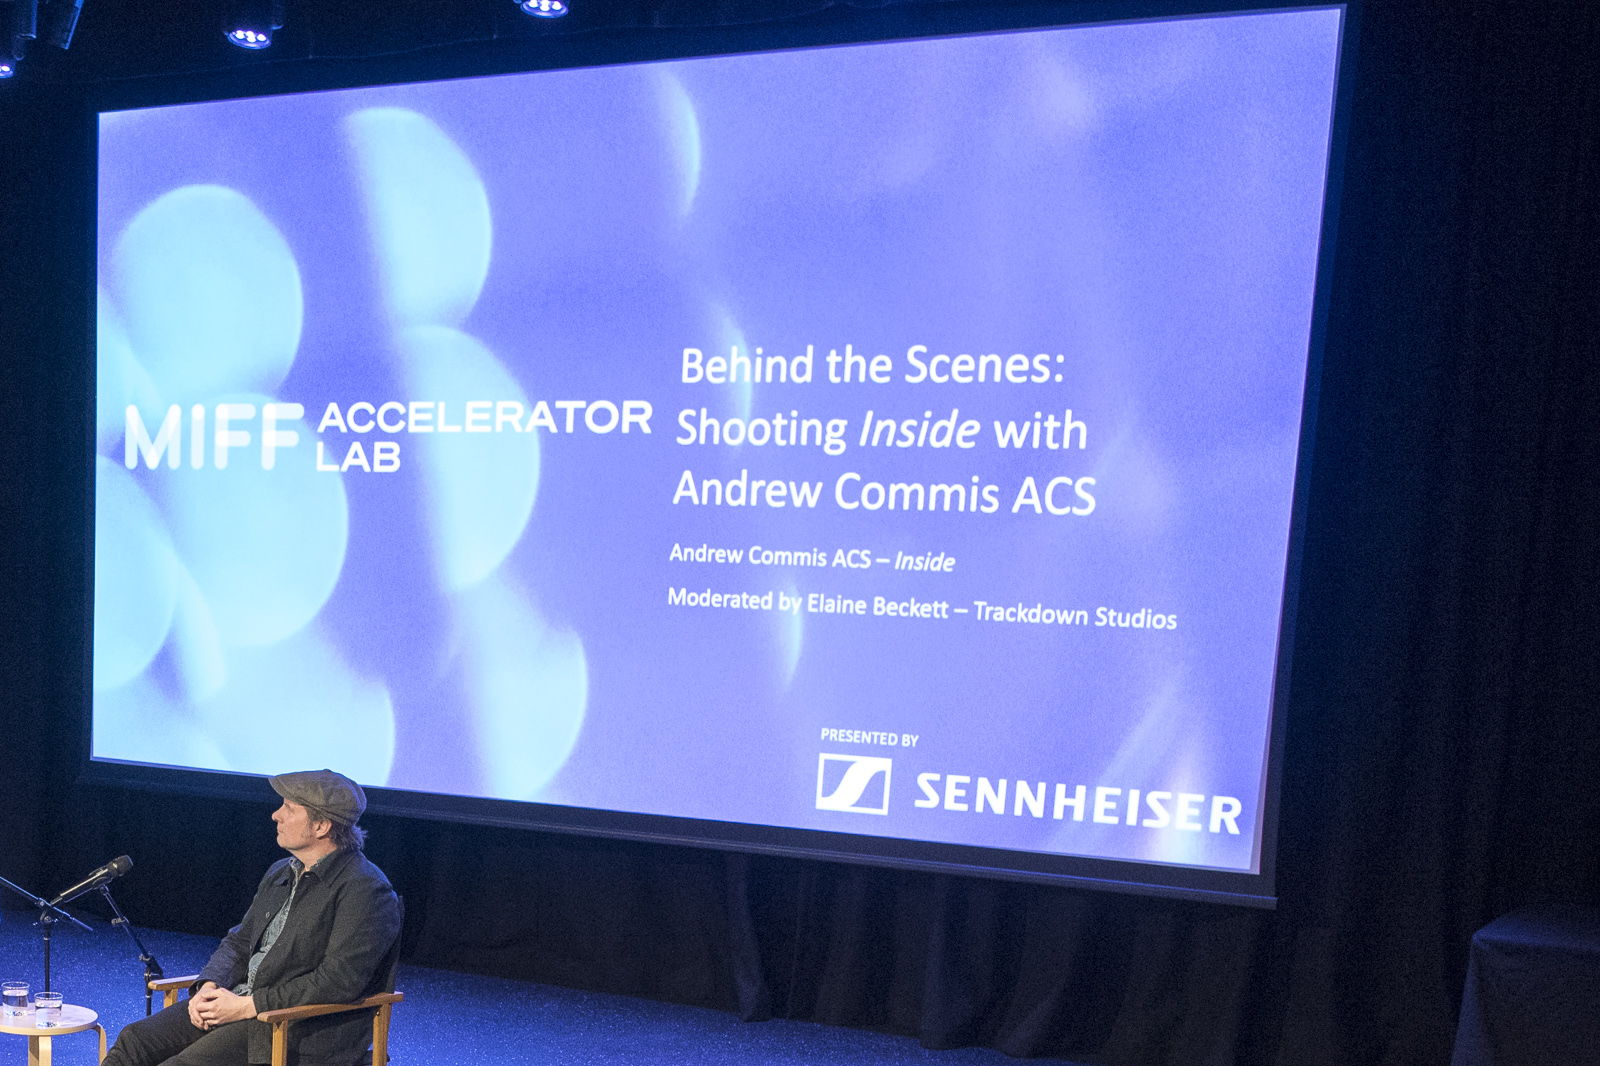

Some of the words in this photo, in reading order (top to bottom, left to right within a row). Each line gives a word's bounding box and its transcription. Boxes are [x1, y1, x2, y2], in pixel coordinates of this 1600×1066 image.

[681, 344, 814, 384] Behind
[825, 343, 893, 384] the
[904, 344, 1066, 384] Scenes:
[124, 403, 305, 470] MIFF
[317, 399, 653, 435] ACCELERATOR
[675, 407, 849, 456] Shooting
[858, 408, 982, 449] Inside
[993, 409, 1088, 450] with
[316, 440, 401, 473] LAB
[672, 469, 824, 507] Andrew
[834, 471, 1000, 514] Commis
[1011, 475, 1097, 516] ACS
[669, 542, 744, 564] Andrew
[748, 545, 827, 568] Commis
[831, 548, 872, 569] ACS
[894, 550, 956, 573] Inside
[667, 586, 773, 611] Moderated
[778, 591, 804, 615] by
[807, 593, 868, 615] Elaine
[872, 595, 950, 619] Beckett
[973, 600, 1090, 625] Trackdown
[1094, 606, 1178, 630] Studios
[820, 727, 899, 747] PRESENTED
[901, 733, 920, 749] BY
[914, 772, 1242, 835] SENNHEISER
